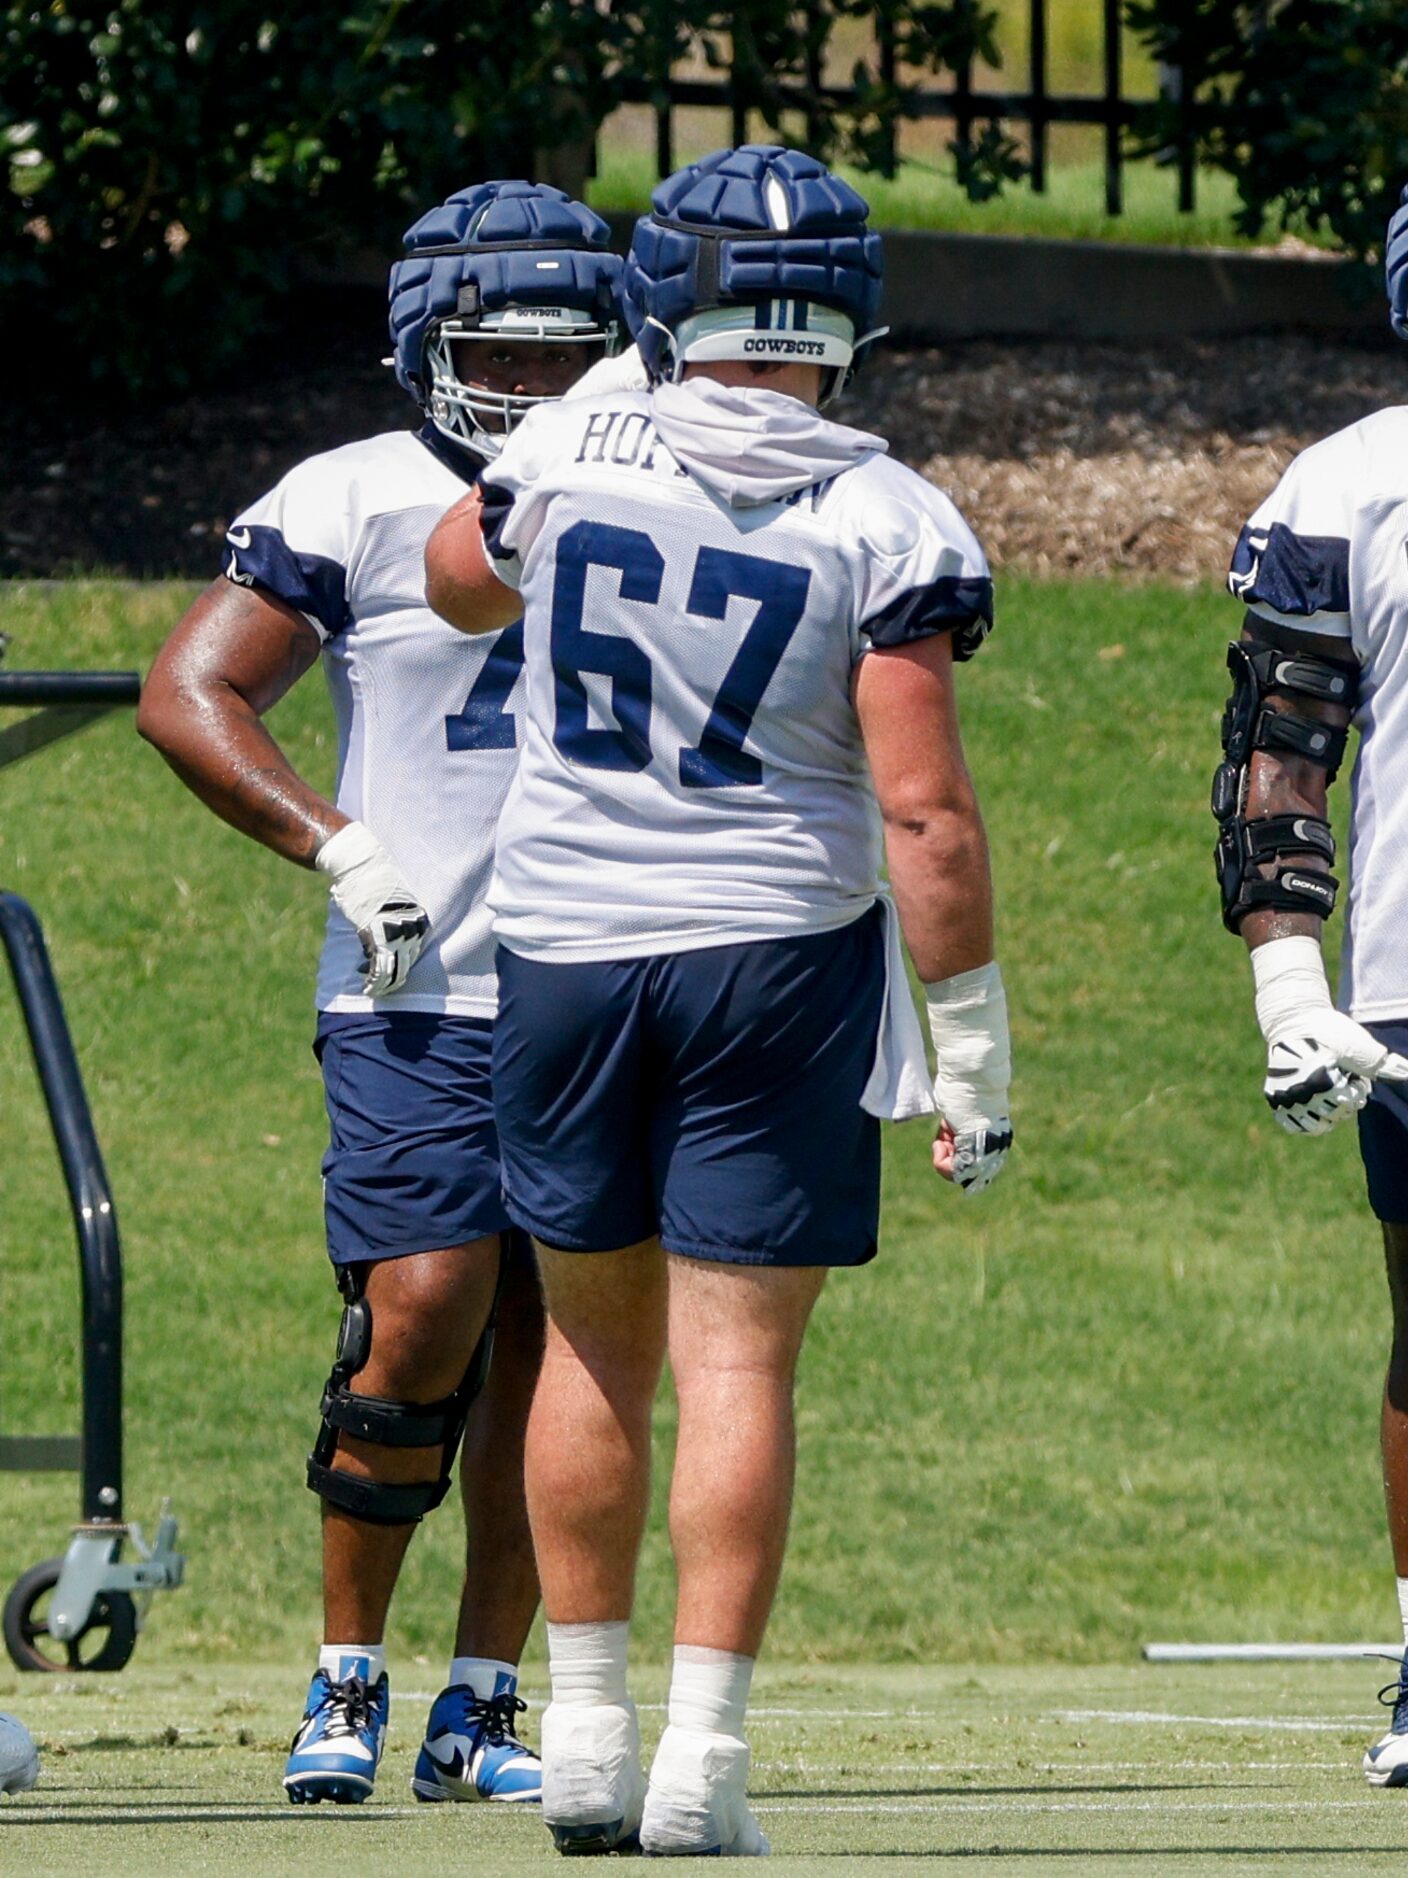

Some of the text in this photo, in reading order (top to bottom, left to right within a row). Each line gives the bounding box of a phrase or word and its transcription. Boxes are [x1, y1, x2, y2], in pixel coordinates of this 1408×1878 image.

[517, 308, 561, 317] COWBOYS
[743, 338, 825, 356] COWBOYS
[549, 519, 812, 788] 67
